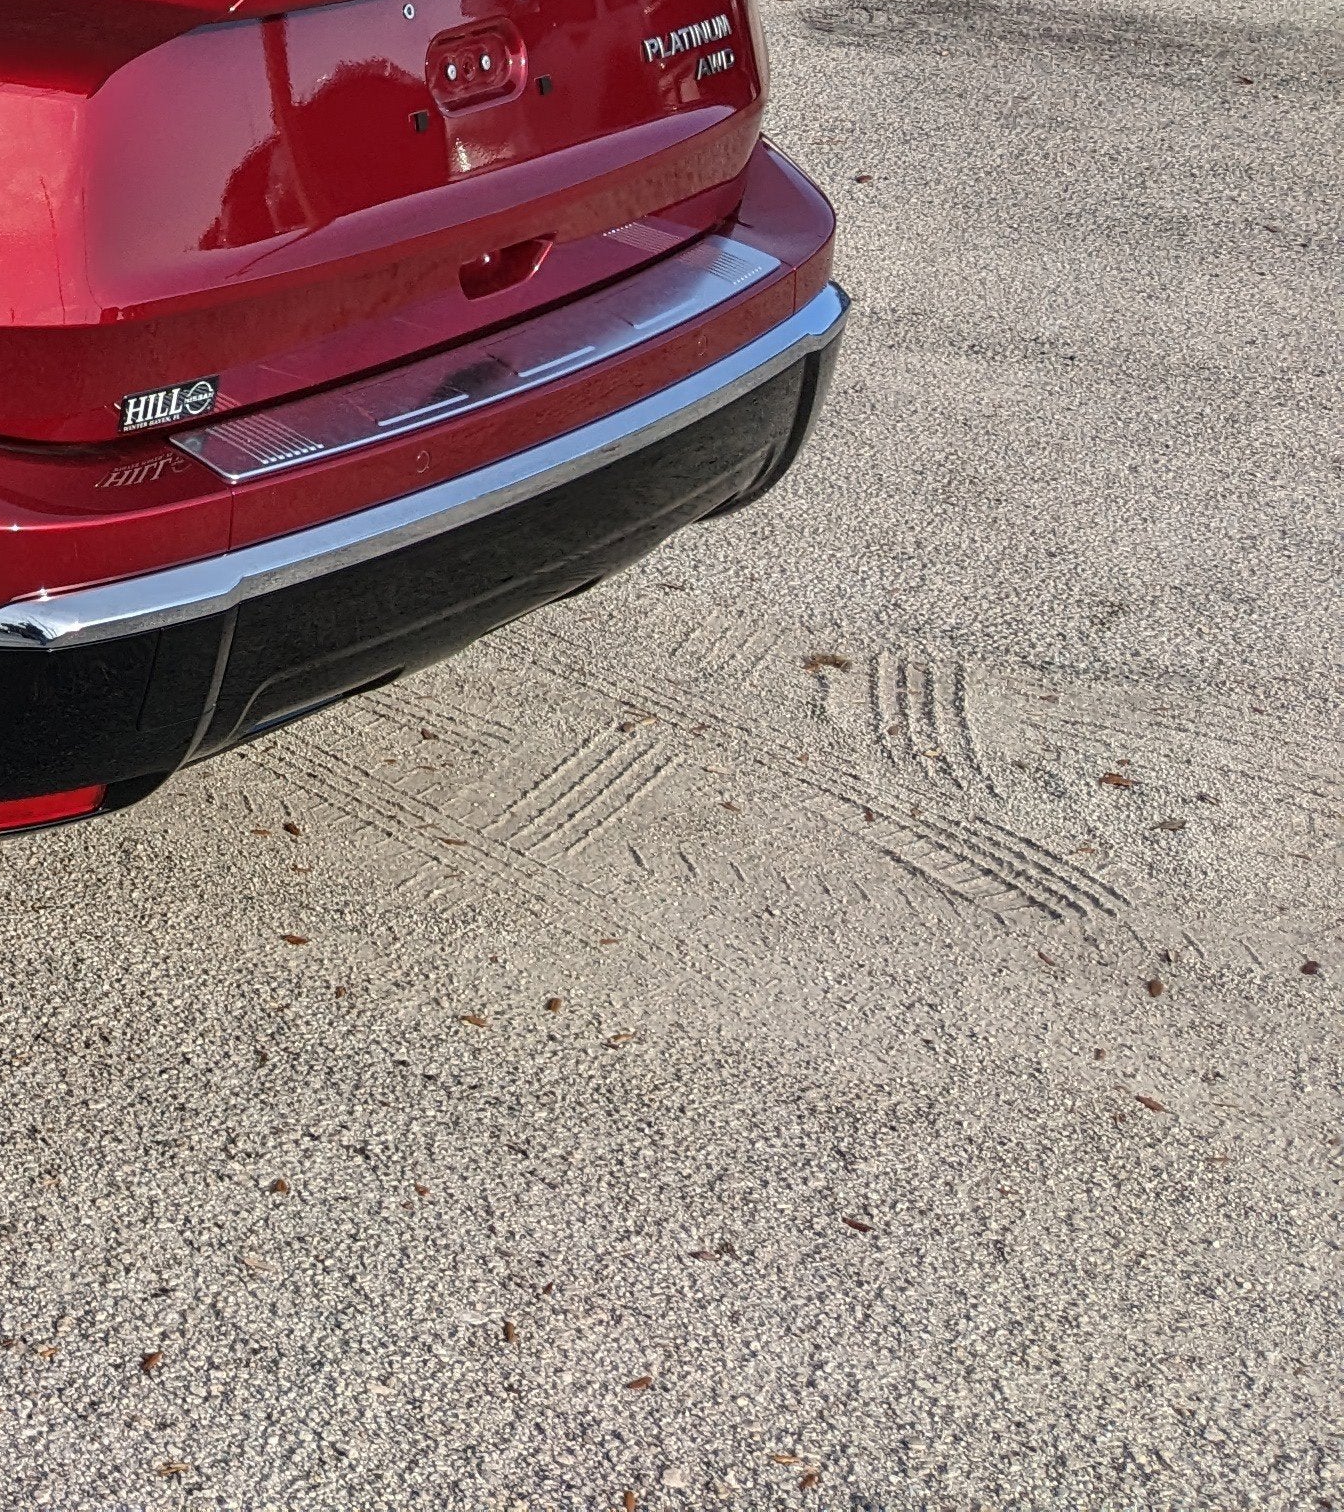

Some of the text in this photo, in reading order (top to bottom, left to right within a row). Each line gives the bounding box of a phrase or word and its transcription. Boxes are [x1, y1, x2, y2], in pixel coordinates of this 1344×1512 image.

[643, 13, 733, 63] PLATINUM
[695, 48, 735, 81] AWD
[123, 387, 184, 427] HILL
